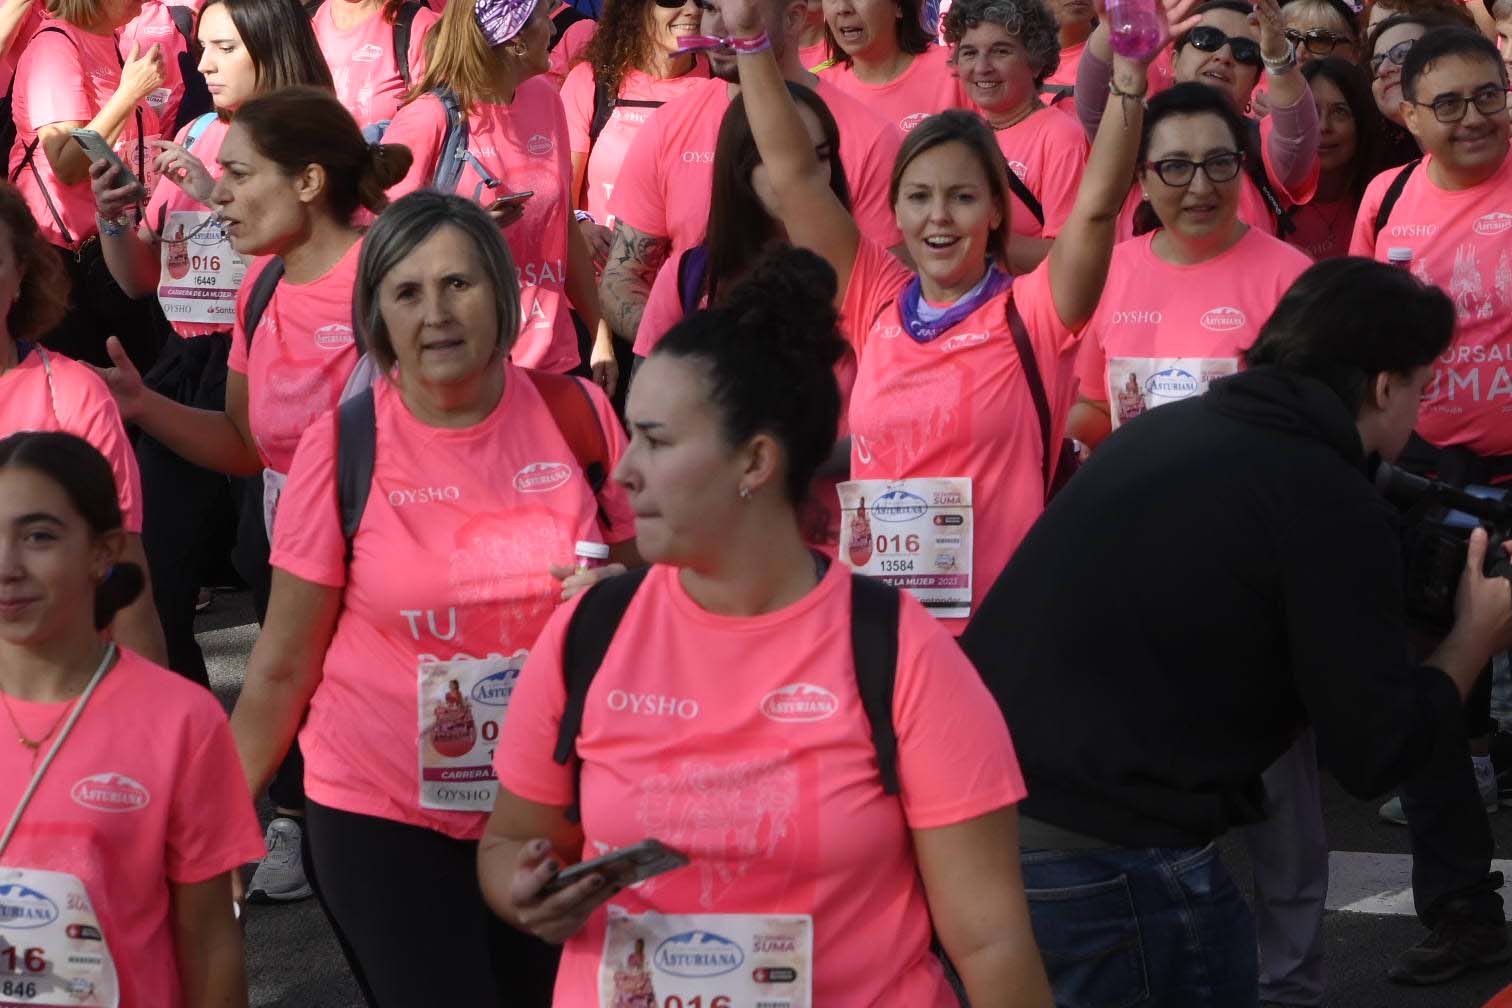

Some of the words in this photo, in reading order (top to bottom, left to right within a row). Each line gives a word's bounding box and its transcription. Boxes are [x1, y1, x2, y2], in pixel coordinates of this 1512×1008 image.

[1391, 225, 1438, 238] OYSHO
[192, 255, 221, 273] 016
[1150, 378, 1196, 393] ASTURIANA
[388, 485, 460, 507] OYSHO
[875, 534, 921, 554] 016
[880, 560, 915, 572] 13584
[906, 577, 936, 587] MUJER
[400, 606, 458, 642] TU
[606, 689, 699, 721] OYSHO
[767, 699, 836, 714] ASTURIANA
[441, 769, 490, 781] CARRERA
[79, 784, 148, 804] ASTURIANA
[437, 788, 491, 803] OYSHO
[660, 948, 738, 969] ASTURIANA
